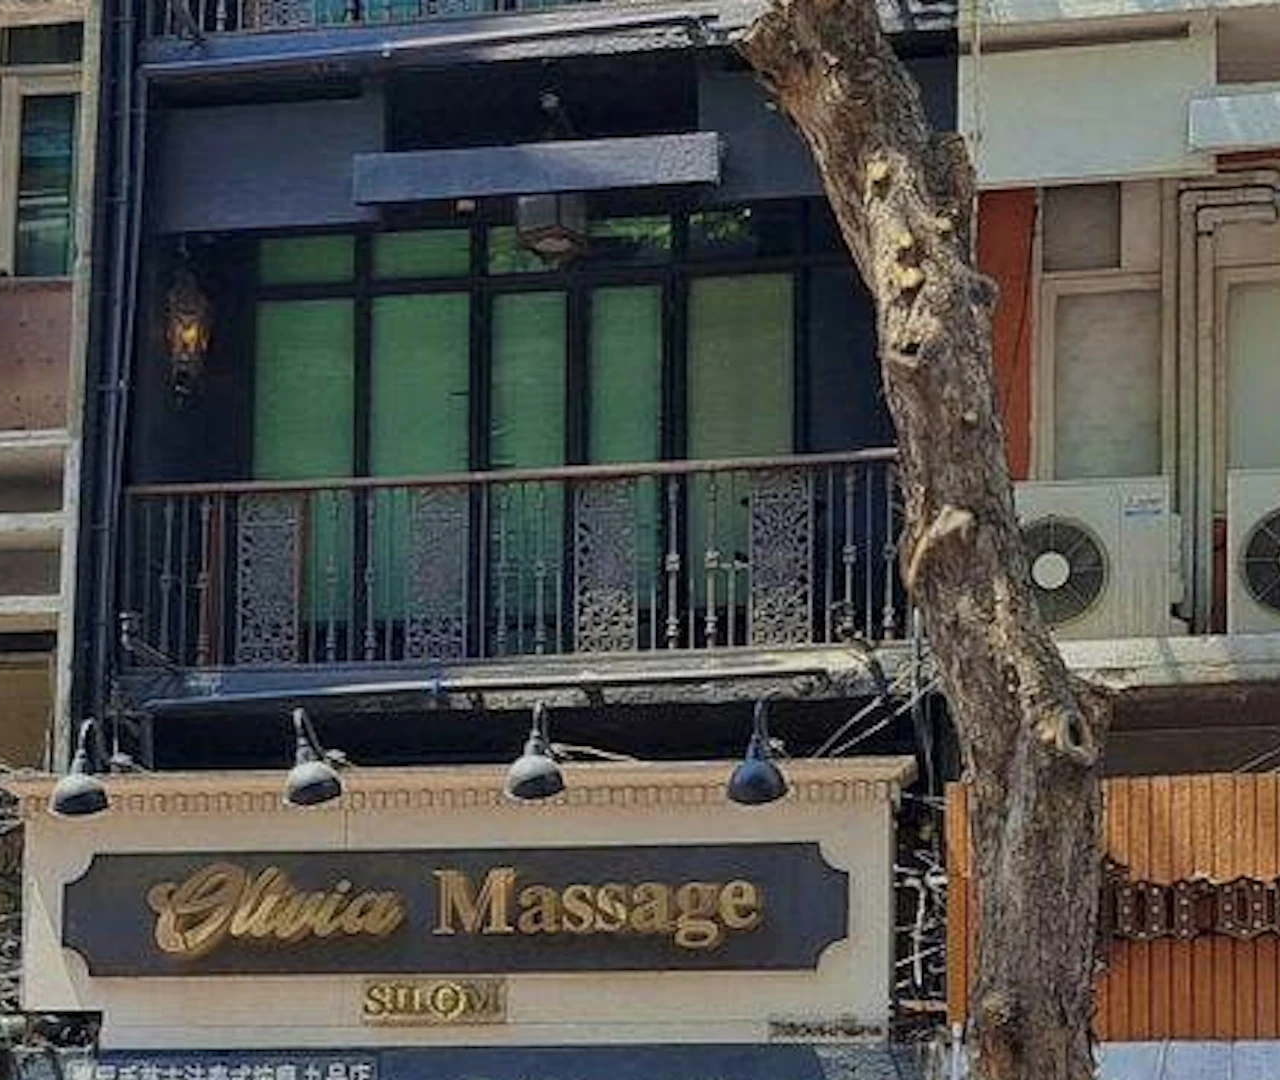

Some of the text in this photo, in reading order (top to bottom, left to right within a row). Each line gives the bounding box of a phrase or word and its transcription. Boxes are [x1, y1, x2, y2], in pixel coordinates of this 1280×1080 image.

[147, 861, 766, 957] Olivia Massage
[363, 979, 502, 1020] SILOM
